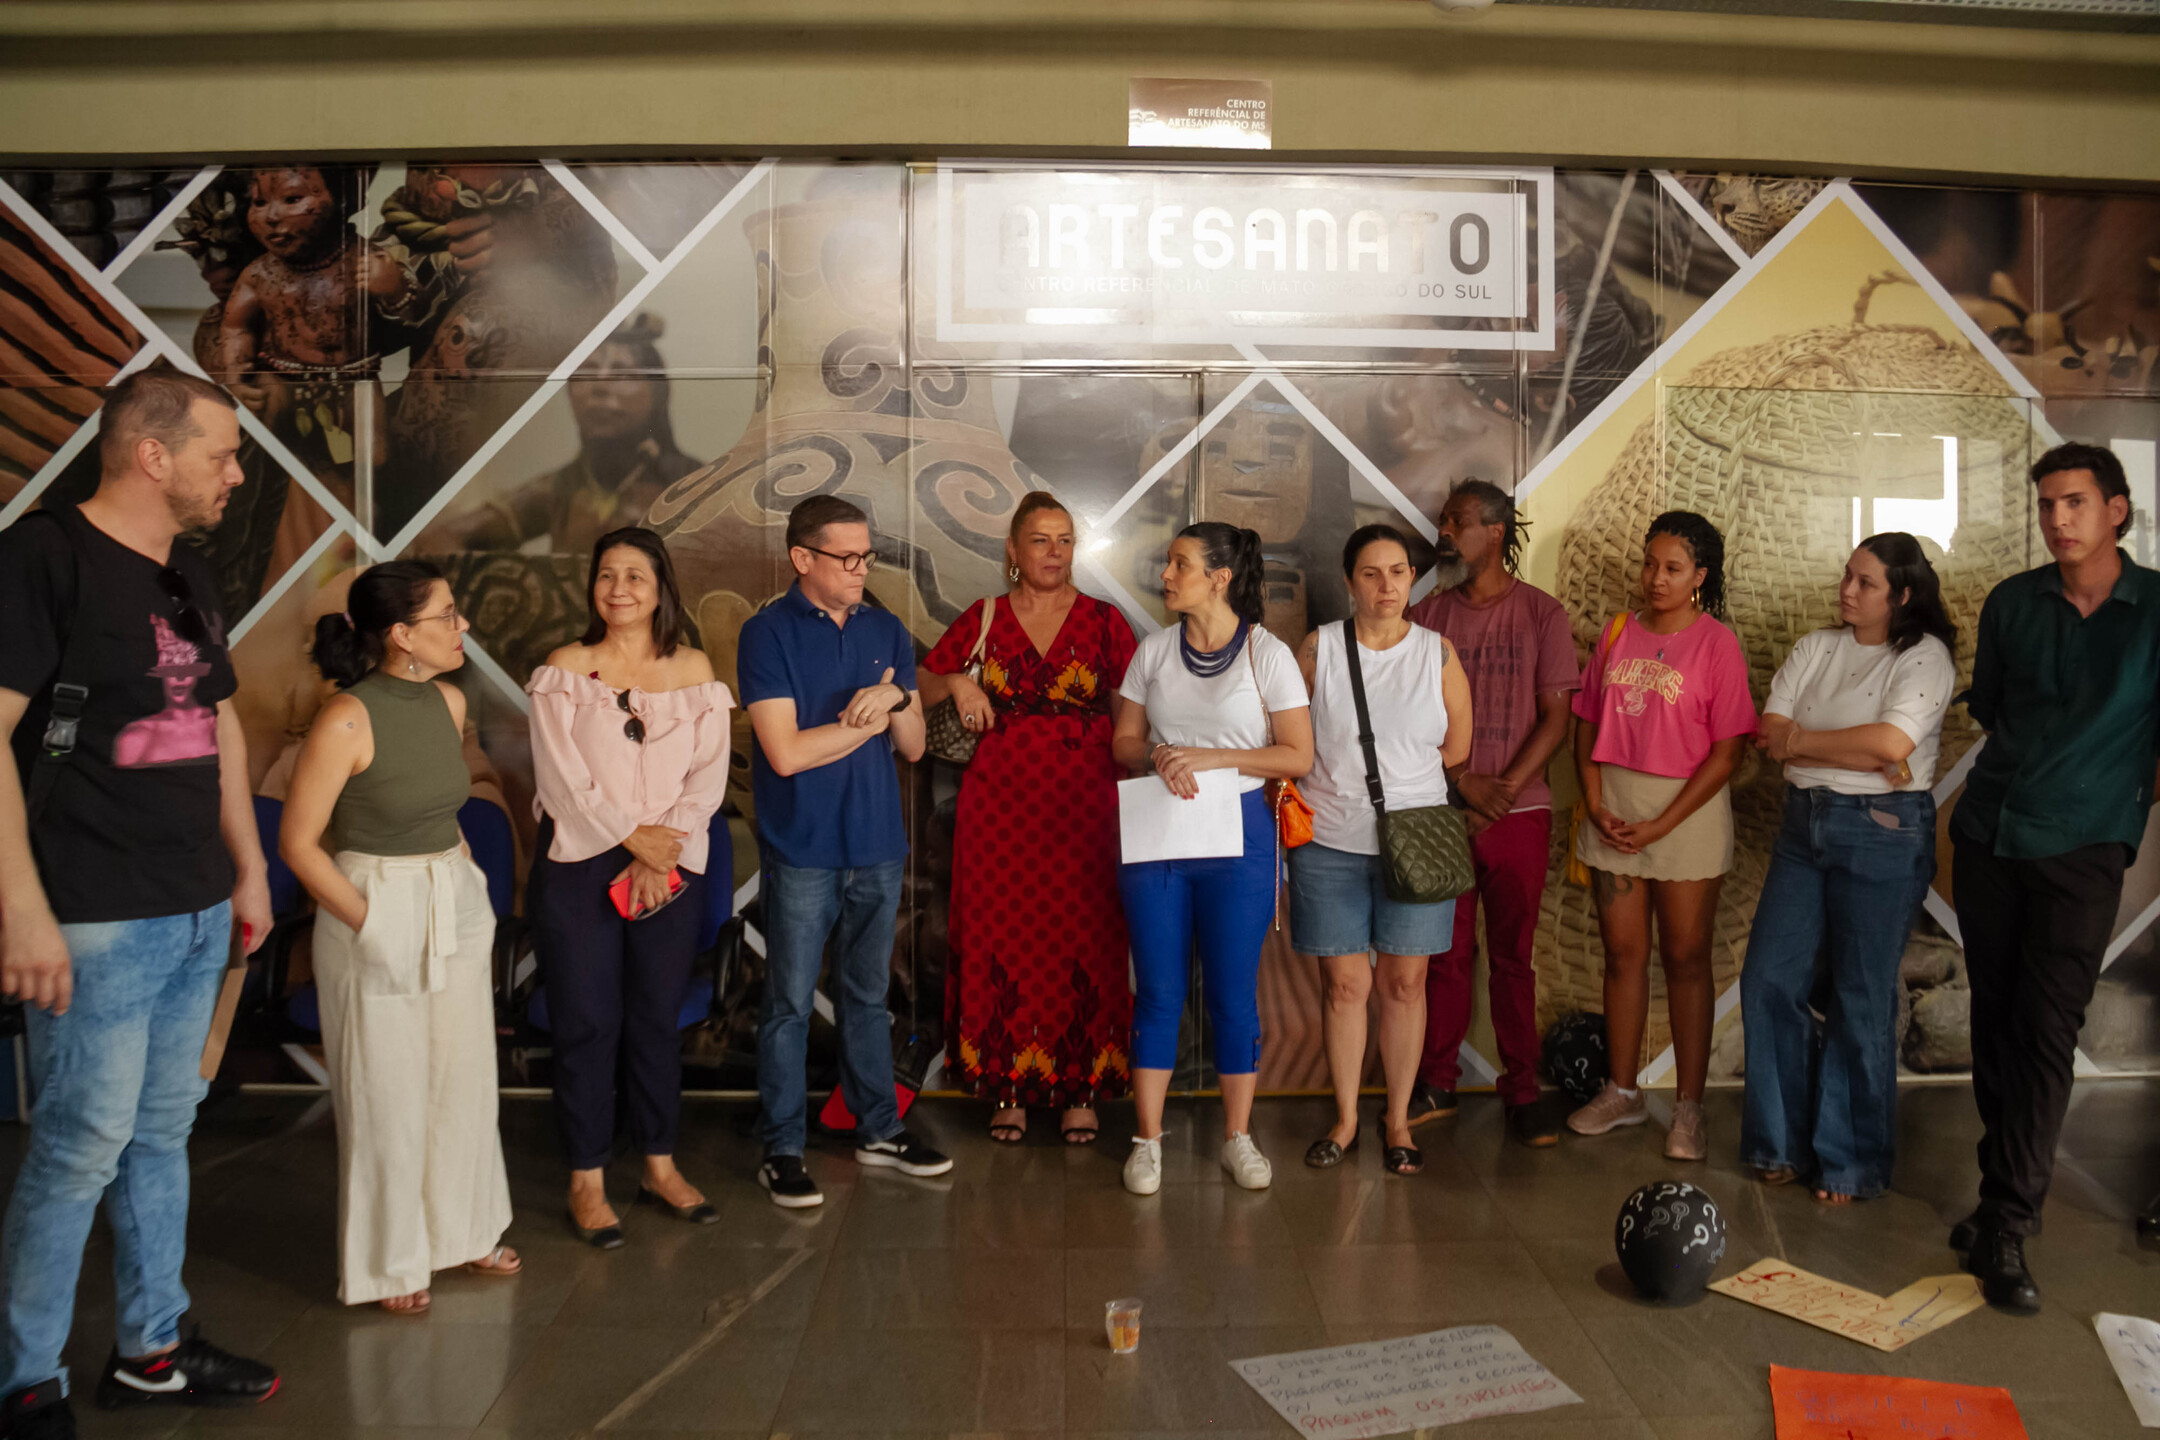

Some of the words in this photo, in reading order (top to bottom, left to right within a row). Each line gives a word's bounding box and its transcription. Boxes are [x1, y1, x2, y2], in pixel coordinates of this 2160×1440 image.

[1226, 98, 1266, 110] CENTRO
[1187, 106, 1251, 120] REFERÊNCIAL
[1253, 111, 1266, 120] DE
[1167, 117, 1231, 130] ARTESANATO
[1234, 120, 1249, 130] DO
[1251, 121, 1266, 131] MS
[999, 204, 1490, 276] ARTESANATO
[1261, 279, 1317, 295] MATO
[1417, 283, 1446, 299] DO
[1454, 283, 1493, 300] SUL
[1300, 1404, 1398, 1433] PAGUEM
[1415, 1397, 1446, 1413] OS
[1454, 1376, 1556, 1407] SUPLENTES
